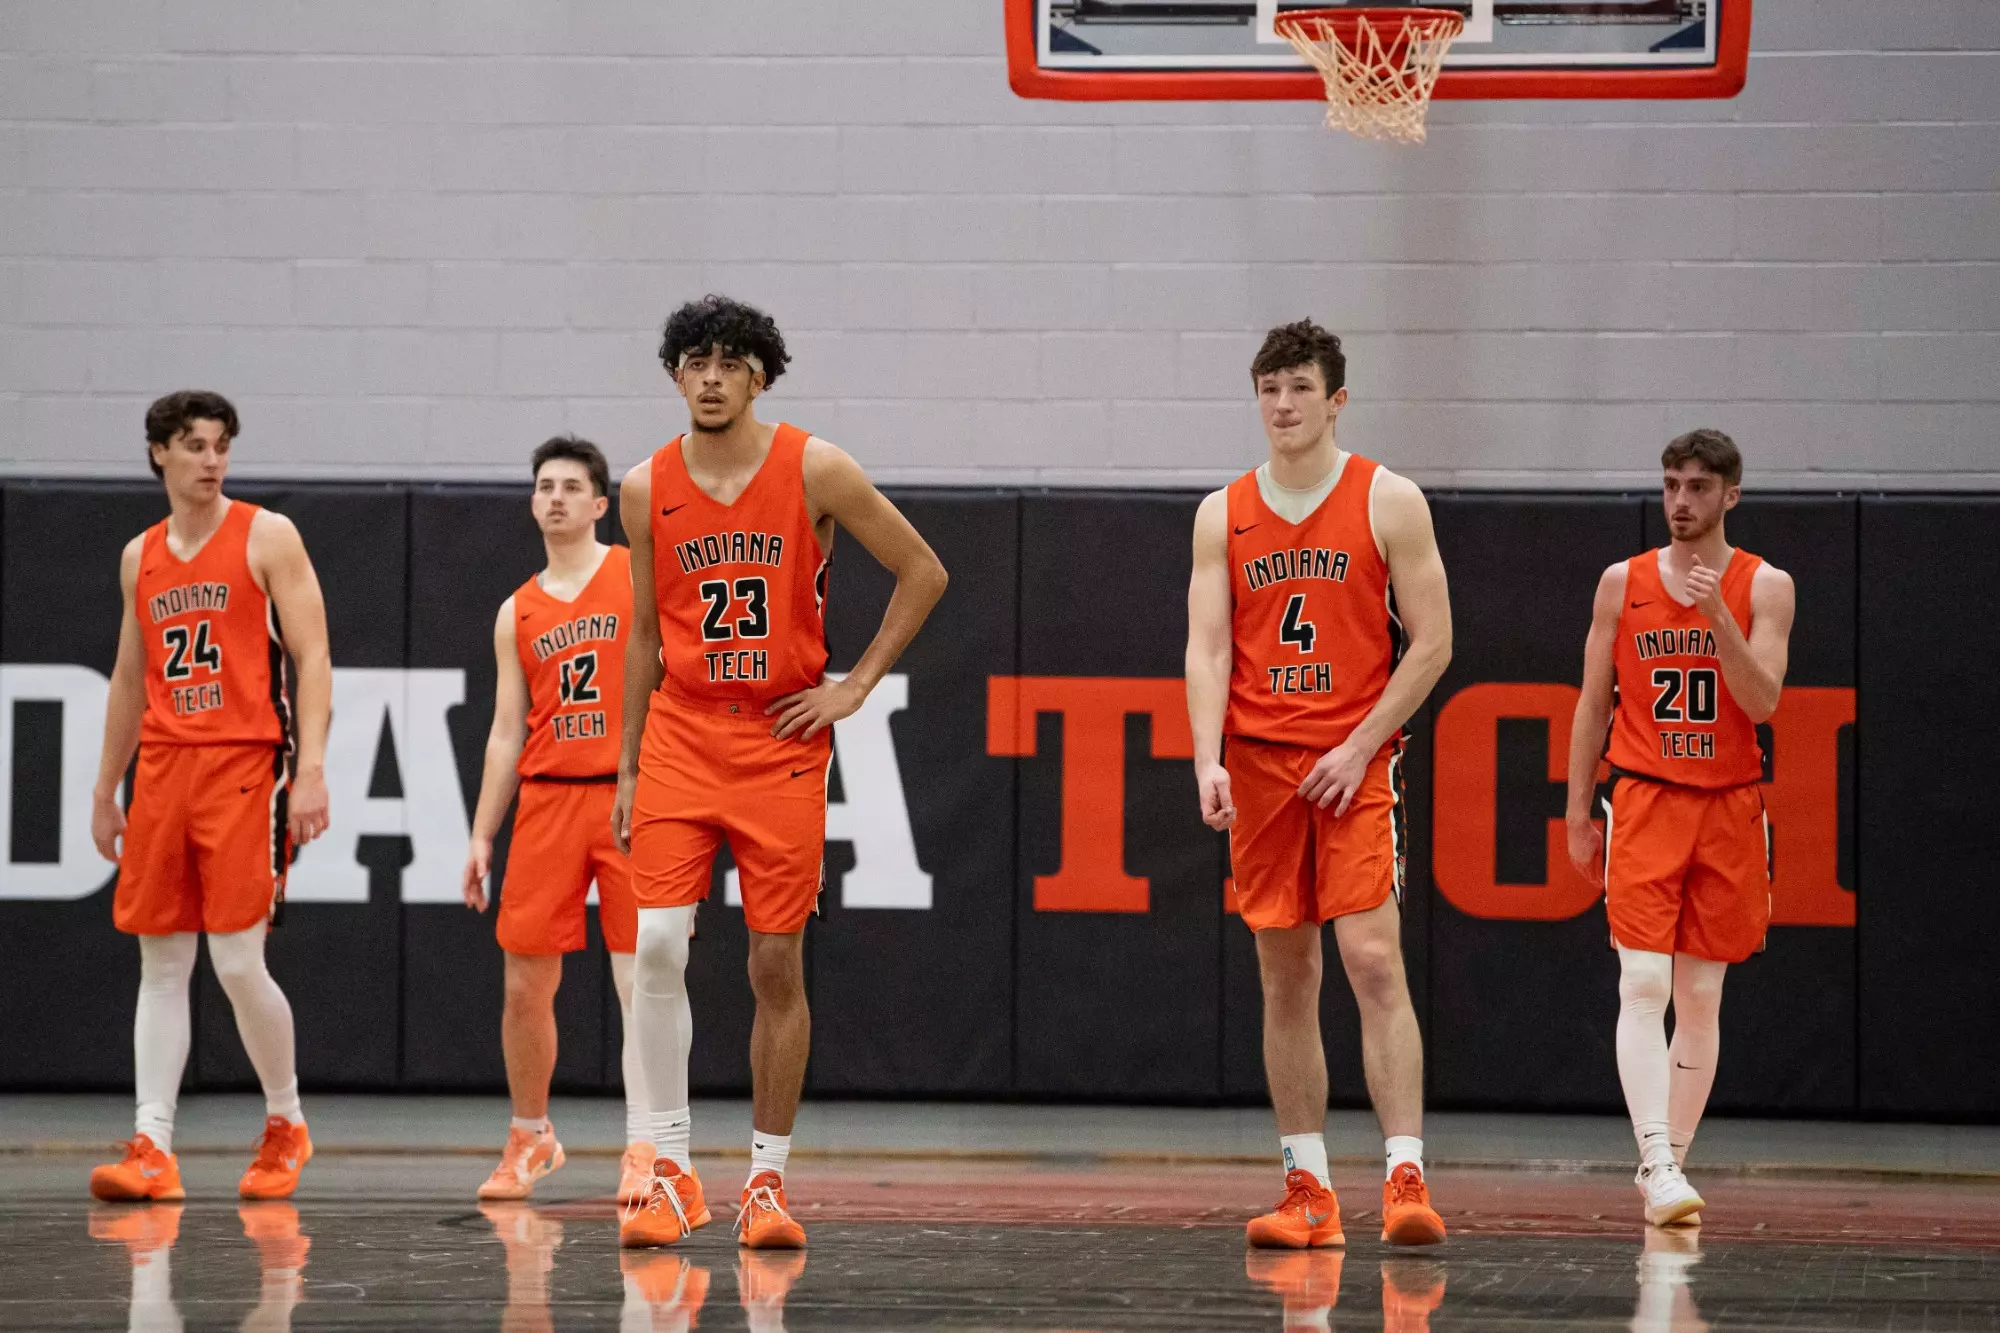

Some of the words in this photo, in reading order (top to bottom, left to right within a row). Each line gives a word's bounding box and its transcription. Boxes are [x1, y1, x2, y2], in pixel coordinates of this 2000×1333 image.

[675, 532, 783, 574] INDIANA
[1244, 548, 1350, 591] INDIANA
[149, 581, 229, 623] INDIANA
[699, 576, 769, 642] 23
[532, 614, 619, 661] INDIANA
[1280, 593, 1316, 654] 4
[1635, 628, 1720, 660] INDIAN
[163, 620, 221, 681] 24
[705, 650, 768, 681] TECH
[172, 680, 223, 715] TECH
[1268, 662, 1332, 694] TECH
[1652, 668, 1717, 723] 20
[552, 711, 606, 742] TECH
[1660, 731, 1715, 759] TECH
